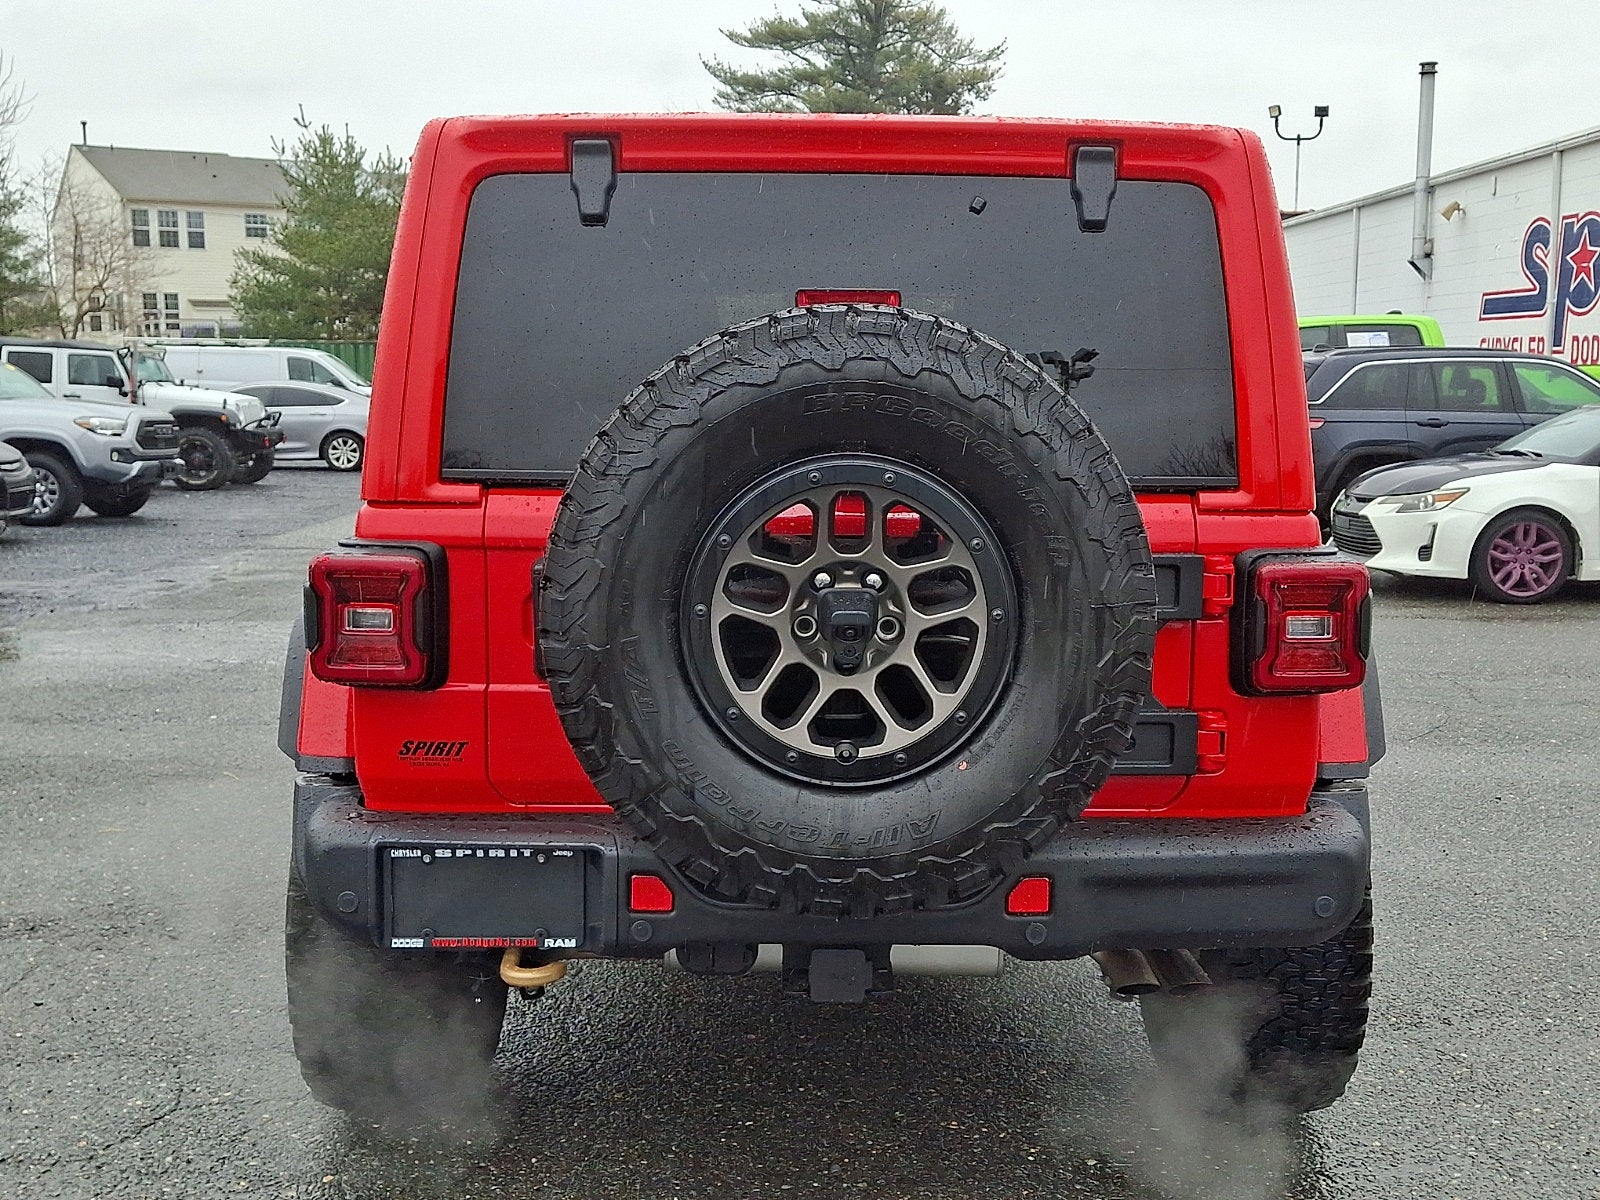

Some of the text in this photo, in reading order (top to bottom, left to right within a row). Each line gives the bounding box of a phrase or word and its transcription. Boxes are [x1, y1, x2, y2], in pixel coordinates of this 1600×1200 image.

[398, 740, 469, 757] SPIRIT
[390, 849, 573, 858] CHRYSLER SPIRIT Jeep
[391, 938, 424, 948] DODGE
[544, 938, 576, 948] RAM
